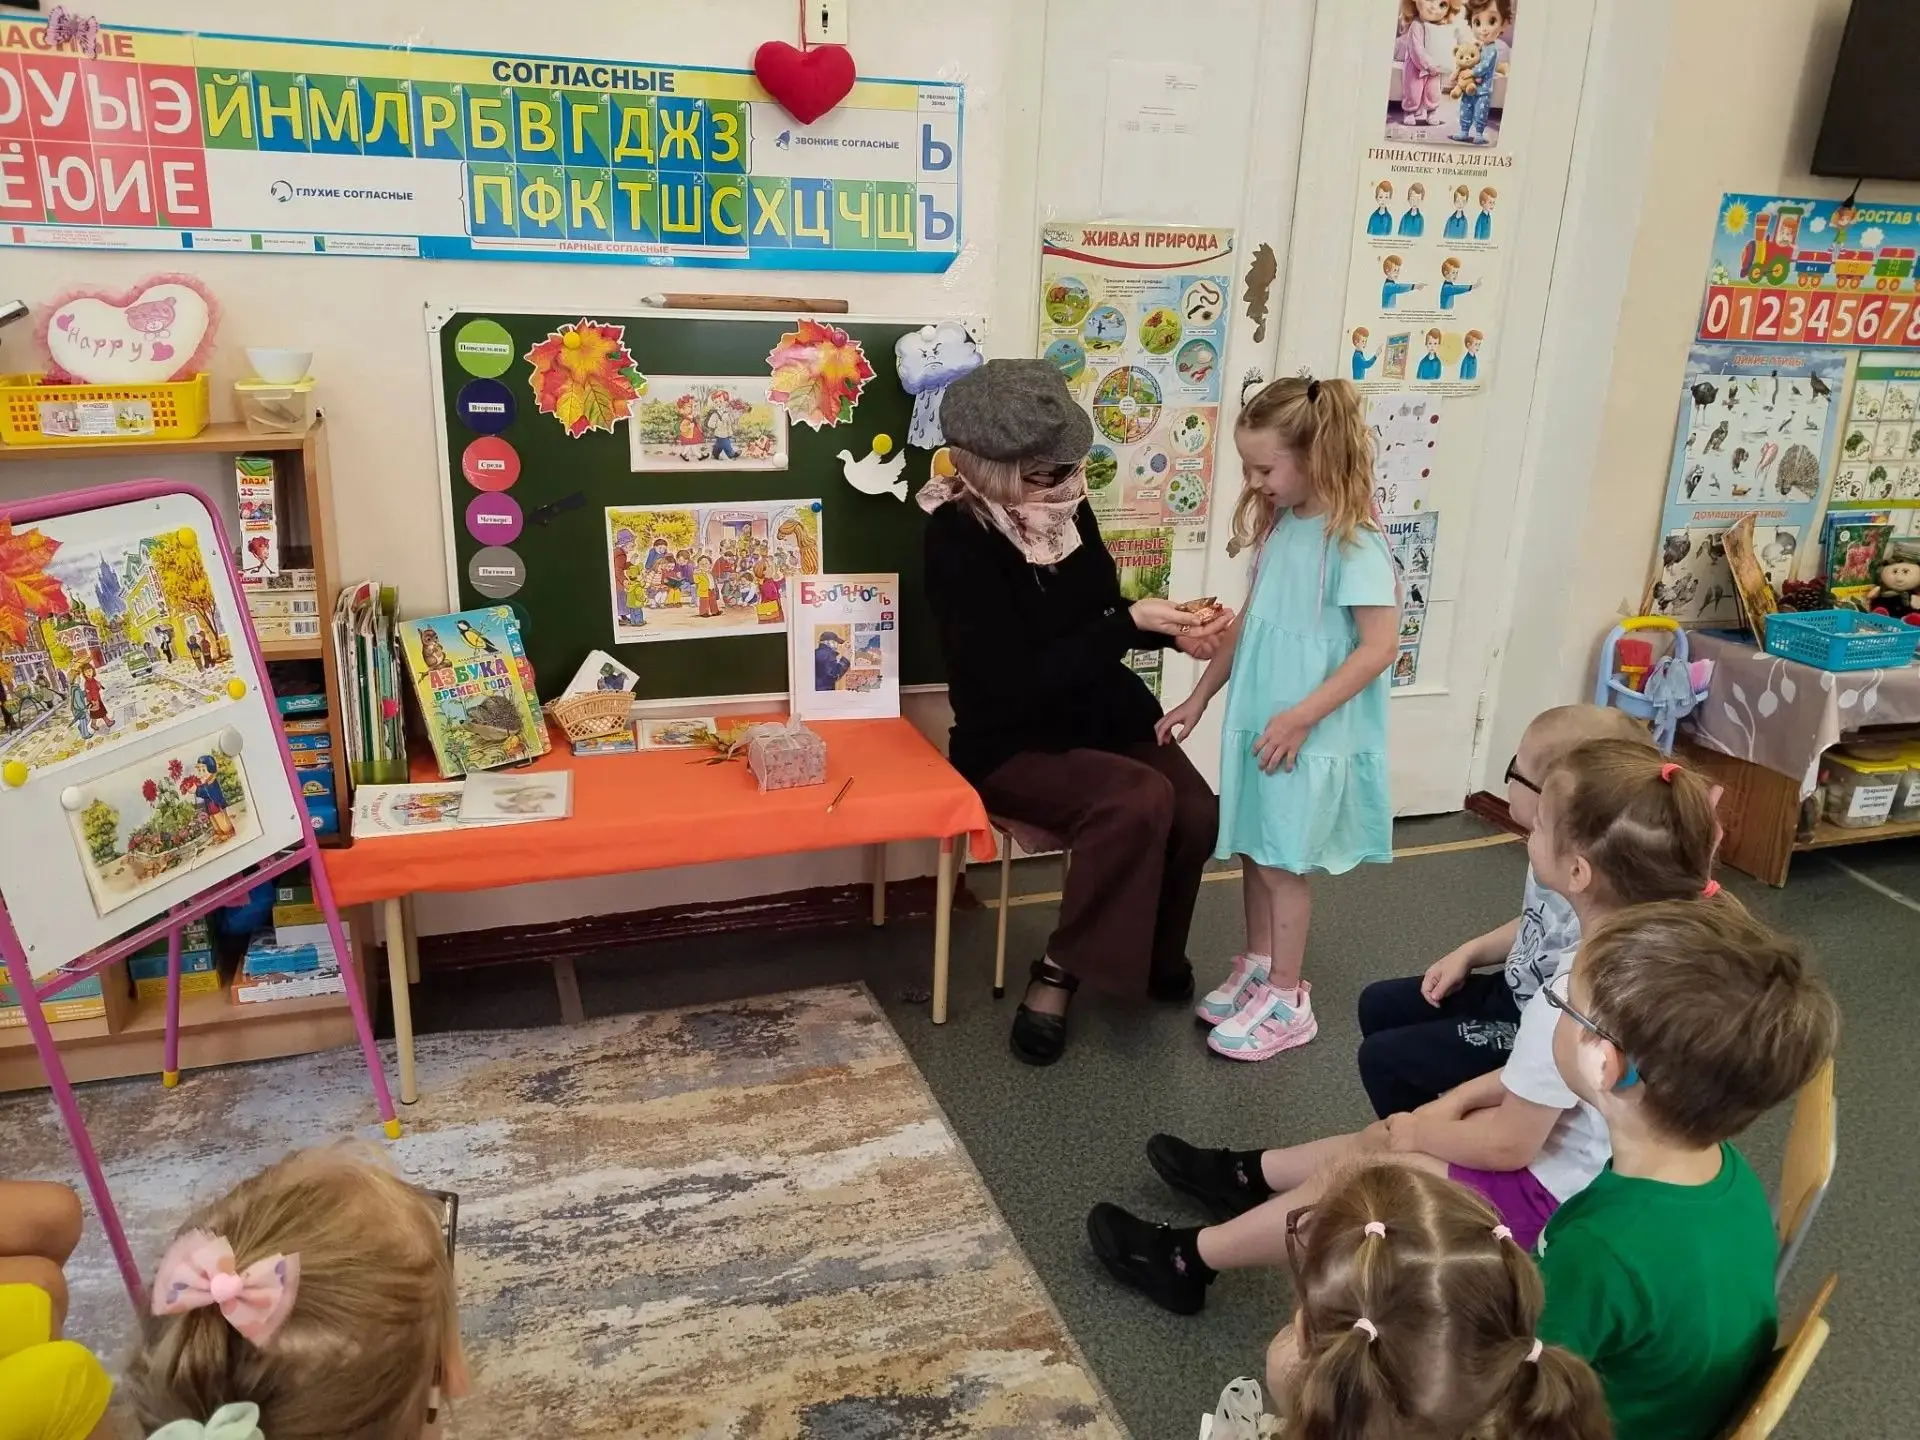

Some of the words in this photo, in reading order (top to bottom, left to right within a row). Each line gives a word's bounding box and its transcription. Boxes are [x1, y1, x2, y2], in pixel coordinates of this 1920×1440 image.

[492, 60, 675, 92] СОГЛАСНЫЕ
[795, 136, 839, 147] ЗВОНКИЕ
[842, 138, 900, 150] СОГЛАСНЫЕ
[1367, 148, 1453, 164] ГИМНАСТИКА
[1457, 154, 1481, 166] ДЛЯ
[1483, 155, 1513, 167] ГЛАЗ
[1390, 165, 1434, 174] КОМПЛЕКС
[1436, 167, 1488, 177] УПРАЖНЕНИЙ
[295, 187, 341, 198] ГЛУХИЕ
[343, 189, 414, 201] СОГЛАСНЫЕ
[1855, 208, 1913, 224] СОСТАВ
[558, 242, 602, 251] ПАРНЫЕ
[606, 244, 669, 254] СОГЛАСНЫЕ
[1081, 230, 1140, 248] ЖИВАЯ
[1145, 232, 1219, 251] ПРИРОДА
[68, 328, 142, 362] Happy
[460, 344, 507, 352] Понедельник
[471, 404, 502, 413] Вторник
[480, 461, 503, 469] Среда
[801, 581, 891, 608] Безопасность
[429, 658, 509, 688] АЗБУКА
[434, 683, 481, 701] ВРЕМЕН
[482, 677, 513, 691] ГОДА
